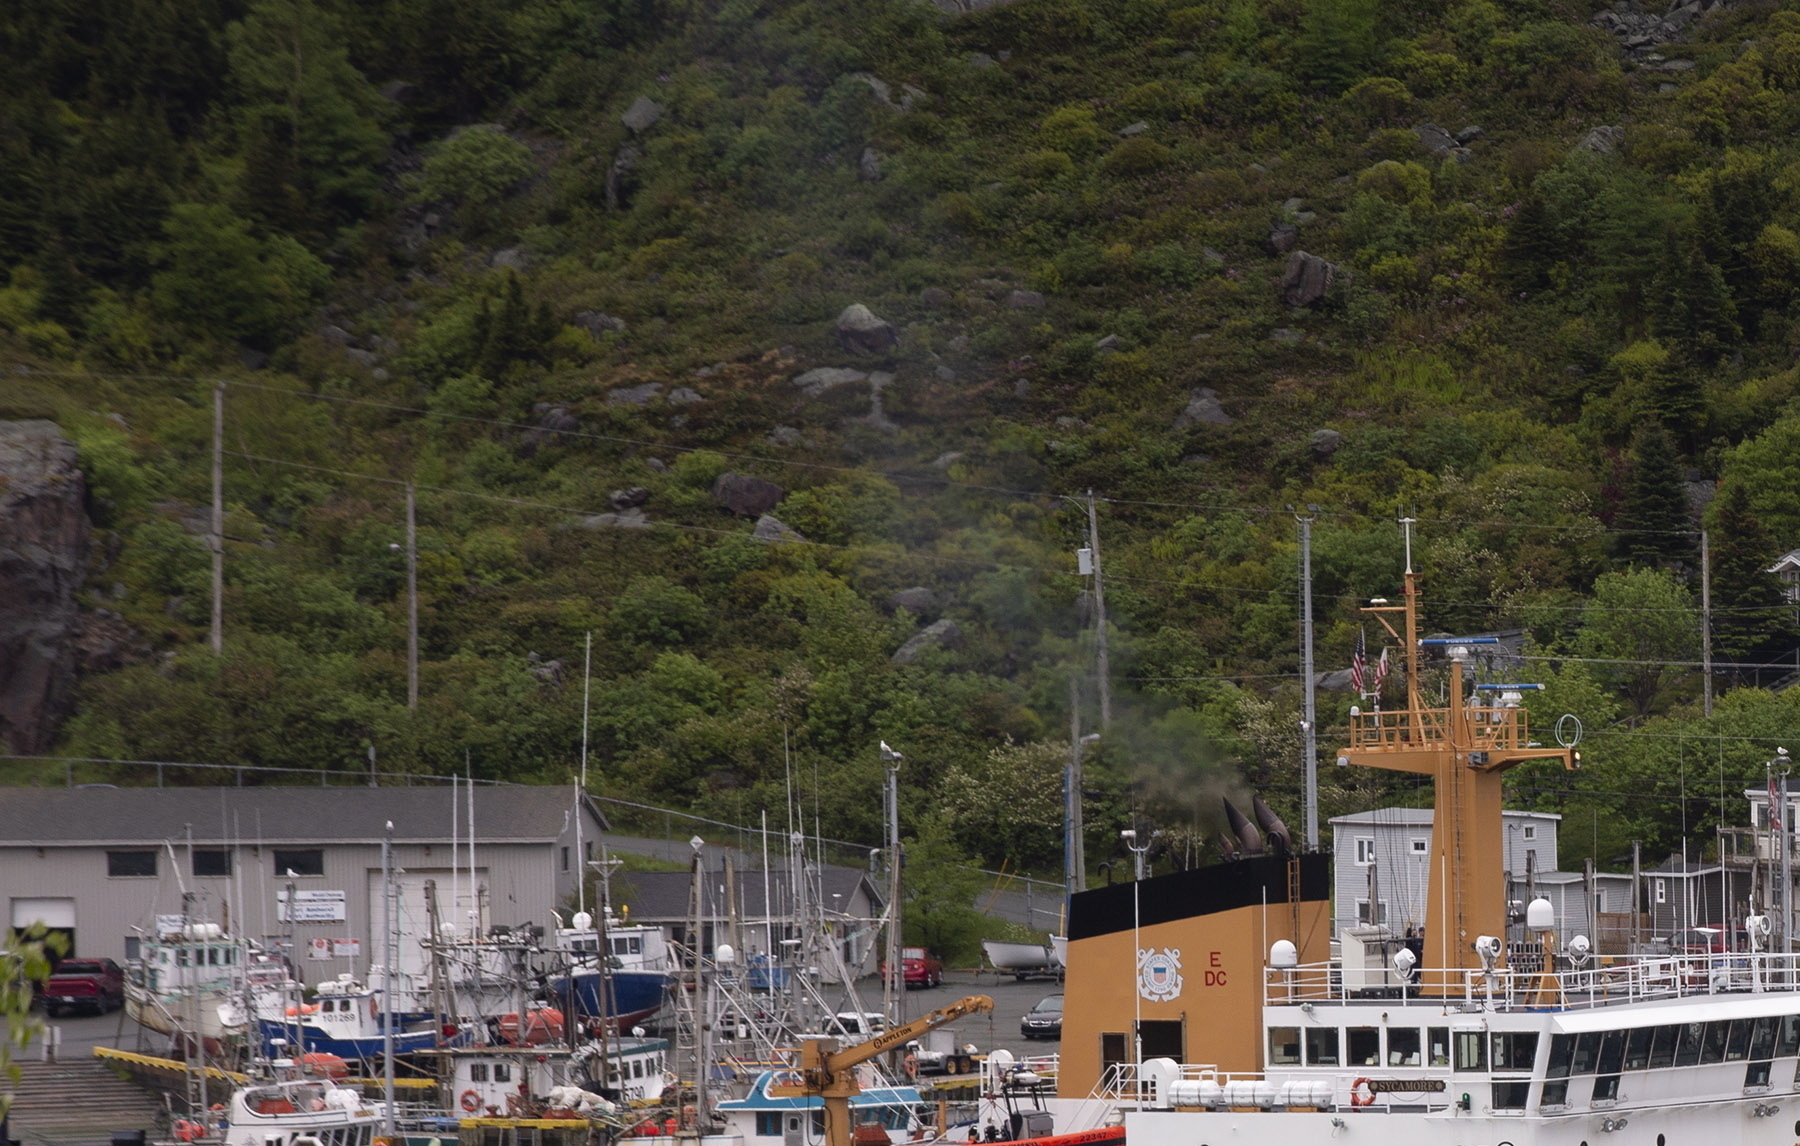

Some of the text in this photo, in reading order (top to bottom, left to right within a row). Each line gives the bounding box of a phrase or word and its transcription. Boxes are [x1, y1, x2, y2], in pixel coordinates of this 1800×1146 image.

[1210, 952, 1221, 967] E
[1204, 970, 1227, 986] DC
[882, 1027, 912, 1043] APPLETON
[1378, 1080, 1435, 1091] SYCAMORE
